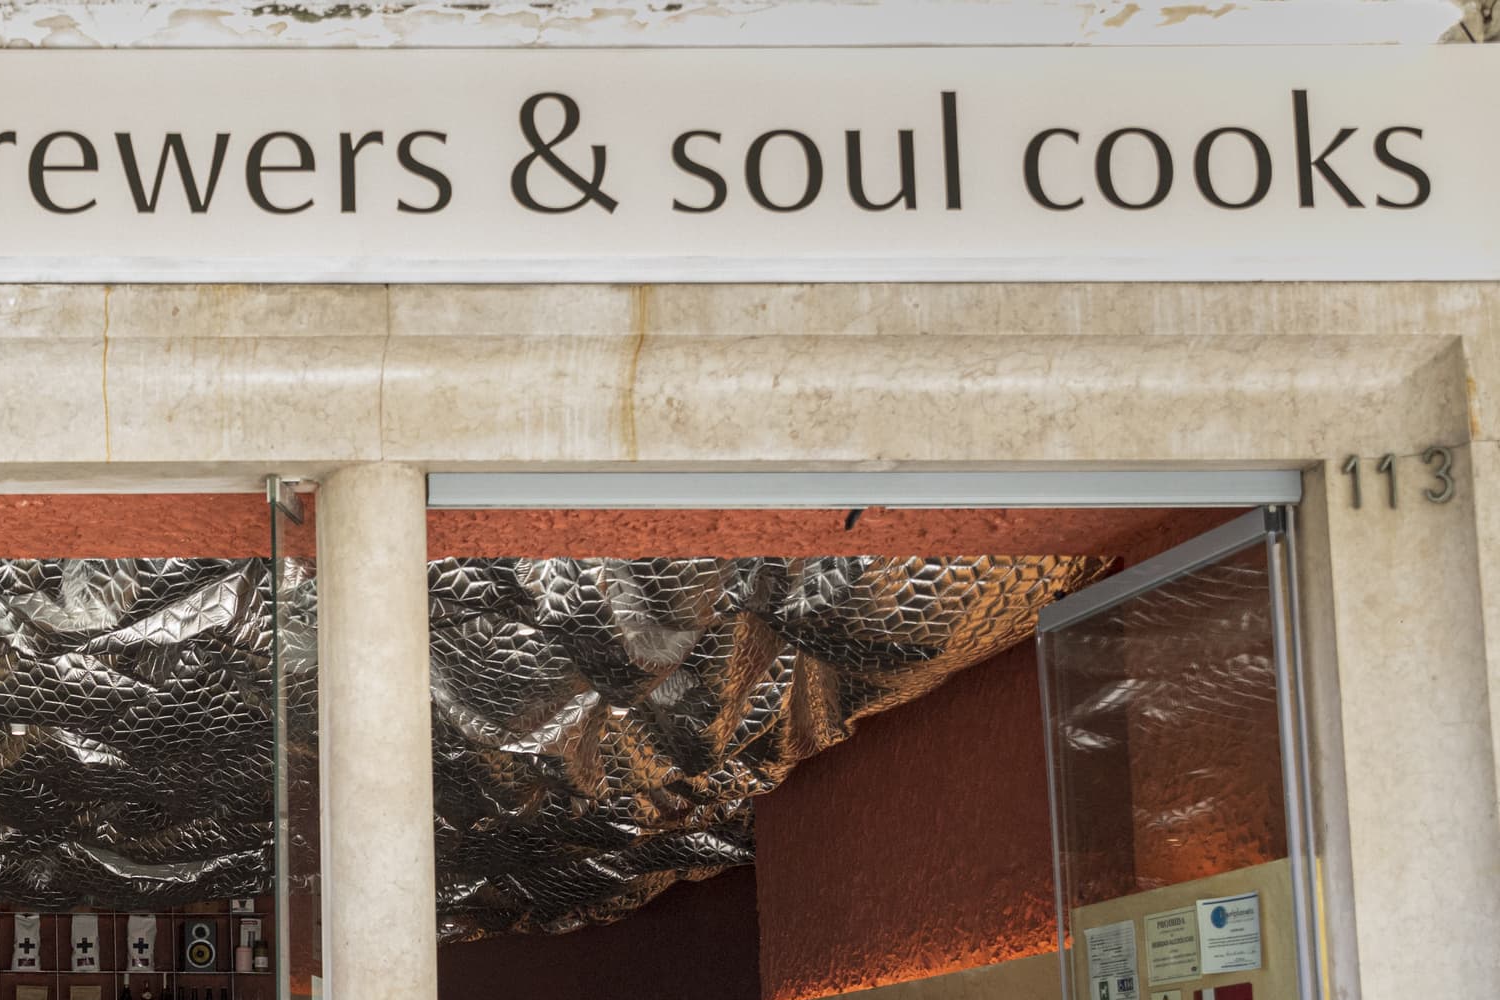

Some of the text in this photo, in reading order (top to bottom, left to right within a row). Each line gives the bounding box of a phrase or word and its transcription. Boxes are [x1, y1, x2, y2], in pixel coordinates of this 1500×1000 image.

[511, 93, 618, 214] &
[673, 91, 961, 213] soul
[1024, 89, 1430, 210] cooks
[1341, 446, 1453, 509] 113
